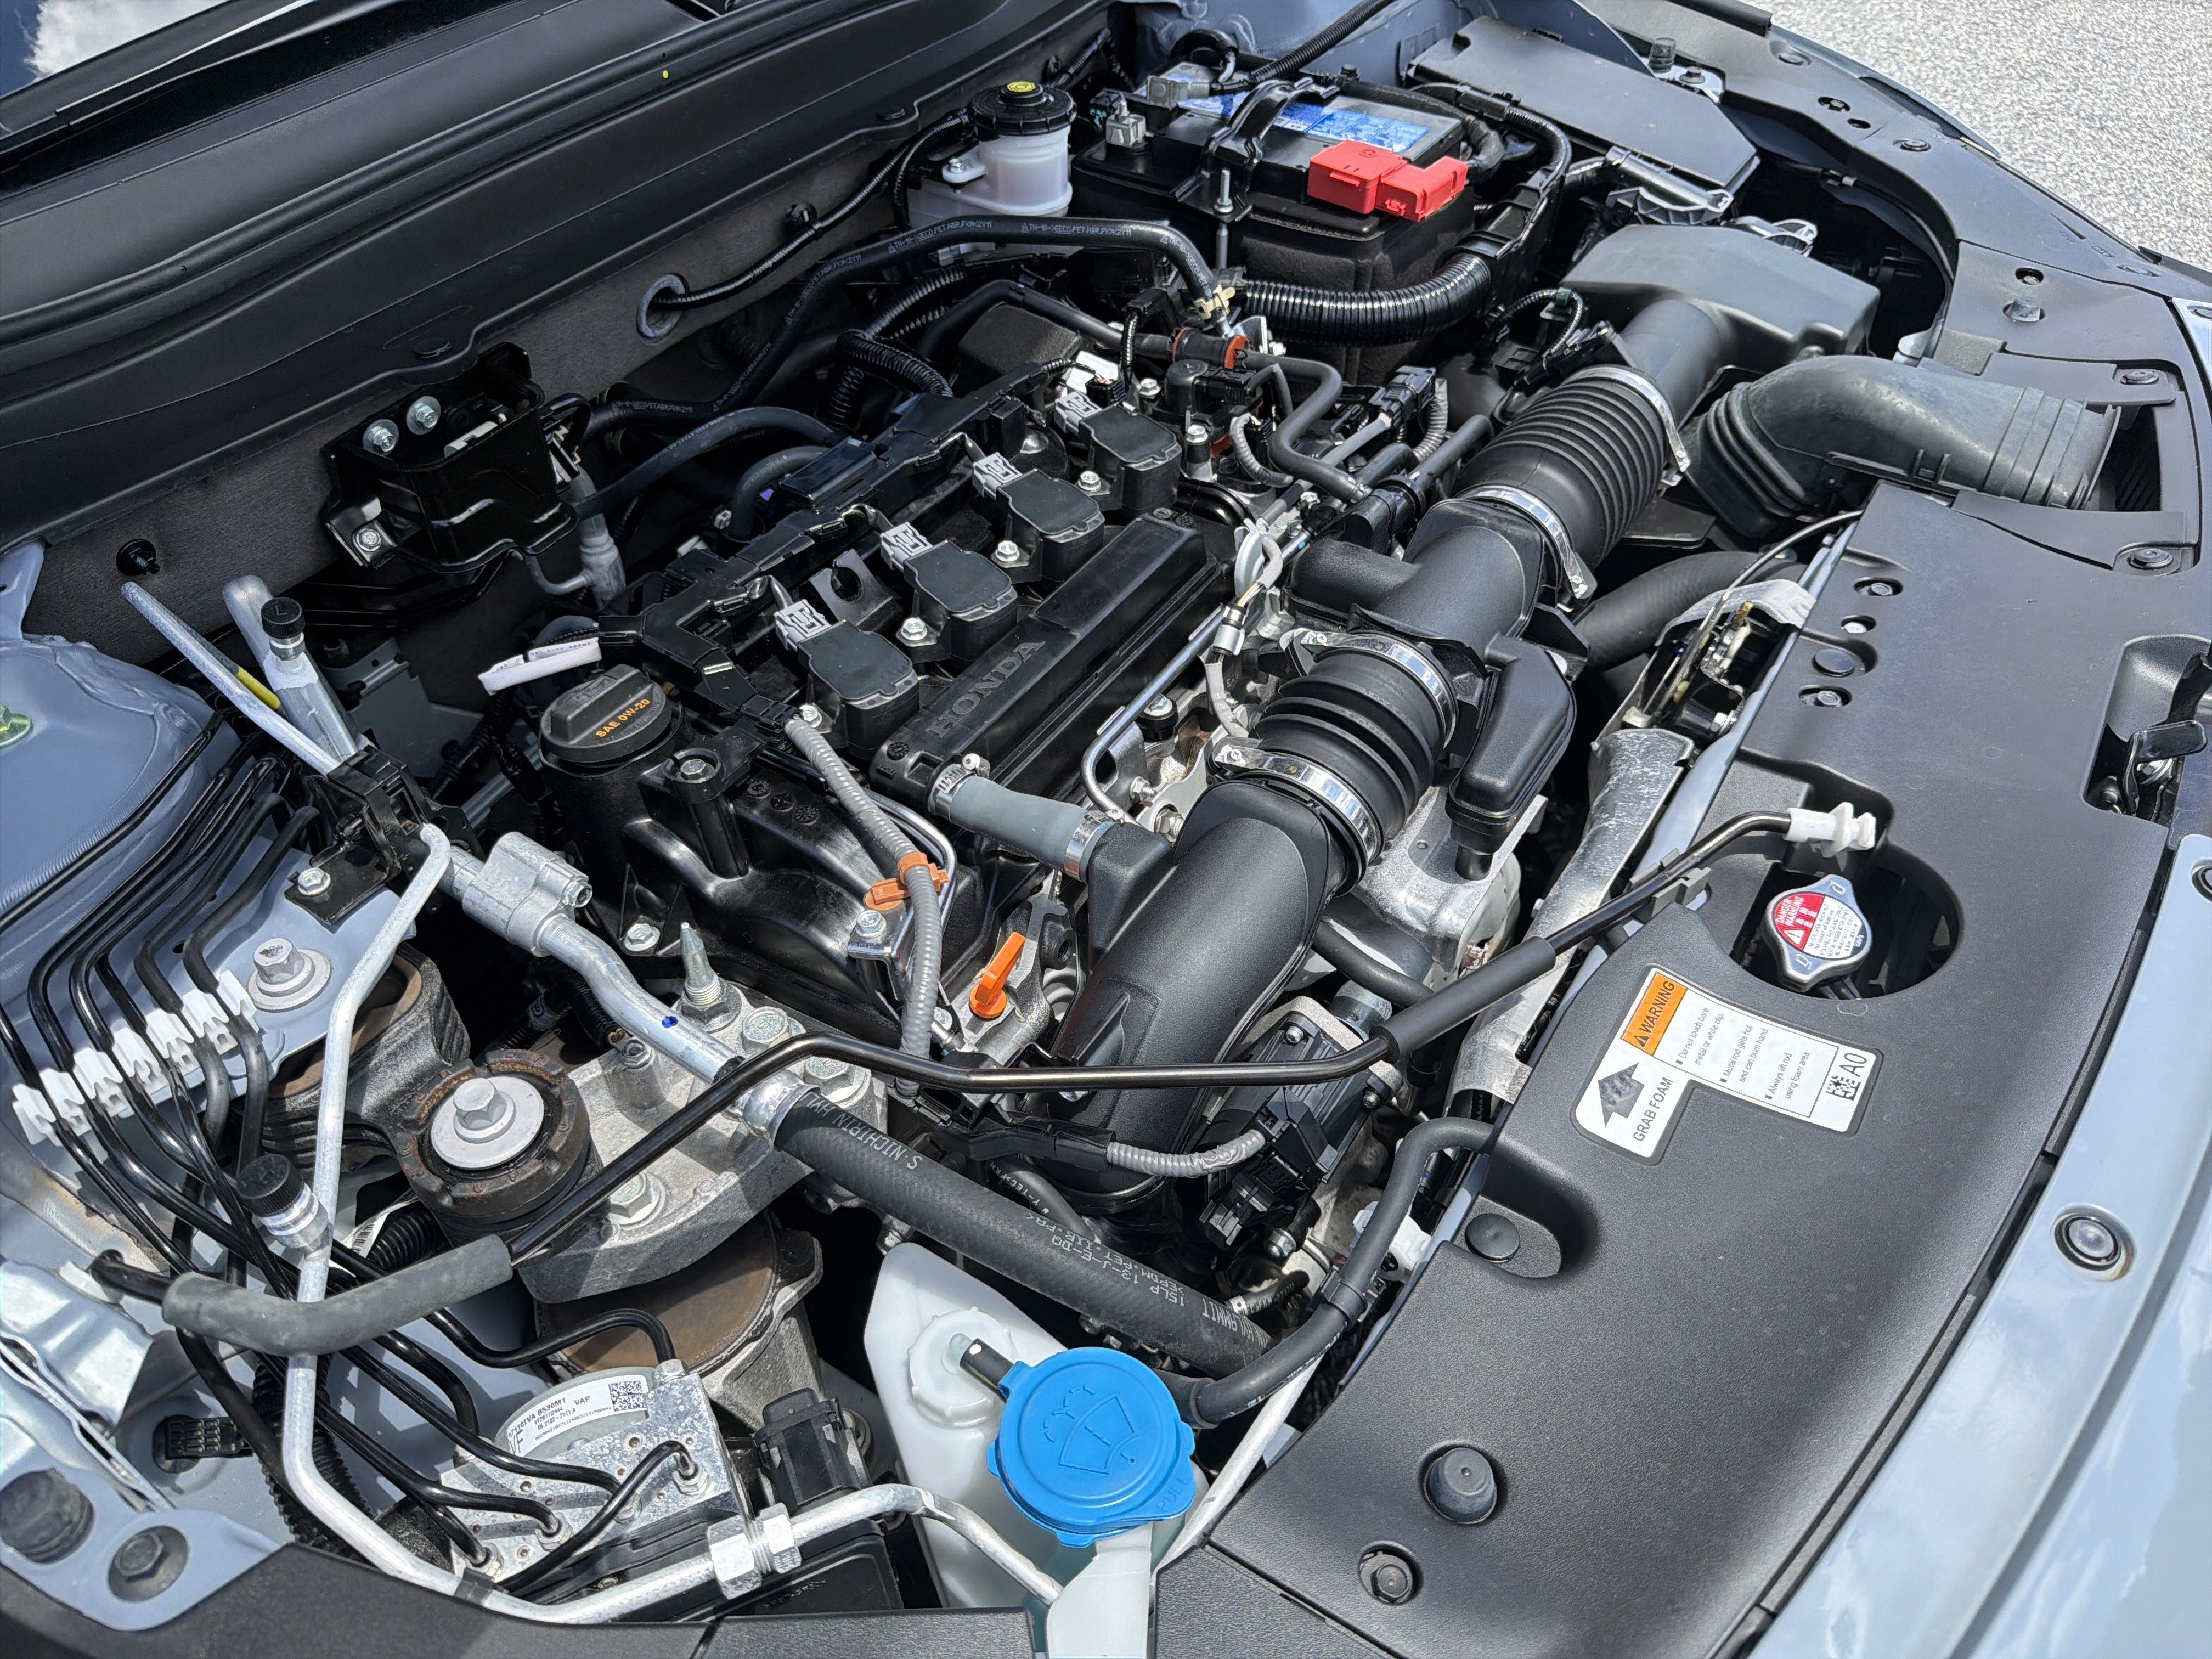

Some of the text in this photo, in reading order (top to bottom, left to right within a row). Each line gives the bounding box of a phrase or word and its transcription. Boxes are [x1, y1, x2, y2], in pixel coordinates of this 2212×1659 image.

[924, 641, 1046, 738] HONDA
[596, 721, 620, 737] SAE
[618, 699, 650, 721] 0W-20
[1775, 898, 1792, 923] DANGER
[1639, 981, 1675, 1034] WARNING
[1678, 1008, 1709, 1059] Do not touch bare
[1695, 1047, 1707, 1065] metal
[1707, 1025, 1718, 1040] white
[1723, 1025, 1753, 1077] Metal rod gets hot
[1748, 1044, 1762, 1059] burn
[1739, 1070, 1750, 1083] and
[1745, 1058, 1755, 1070] can
[1768, 1052, 1792, 1094] Always lift rod
[1790, 1066, 1804, 1081] foam
[1633, 1077, 1673, 1141] GRAB FOAM
[1784, 1081, 1799, 1099] using
[509, 1414, 536, 1439] 57110TVA
[574, 1396, 590, 1406] VAP
[509, 1429, 523, 1455] VF
[1155, 1477, 1192, 1513] PULL
